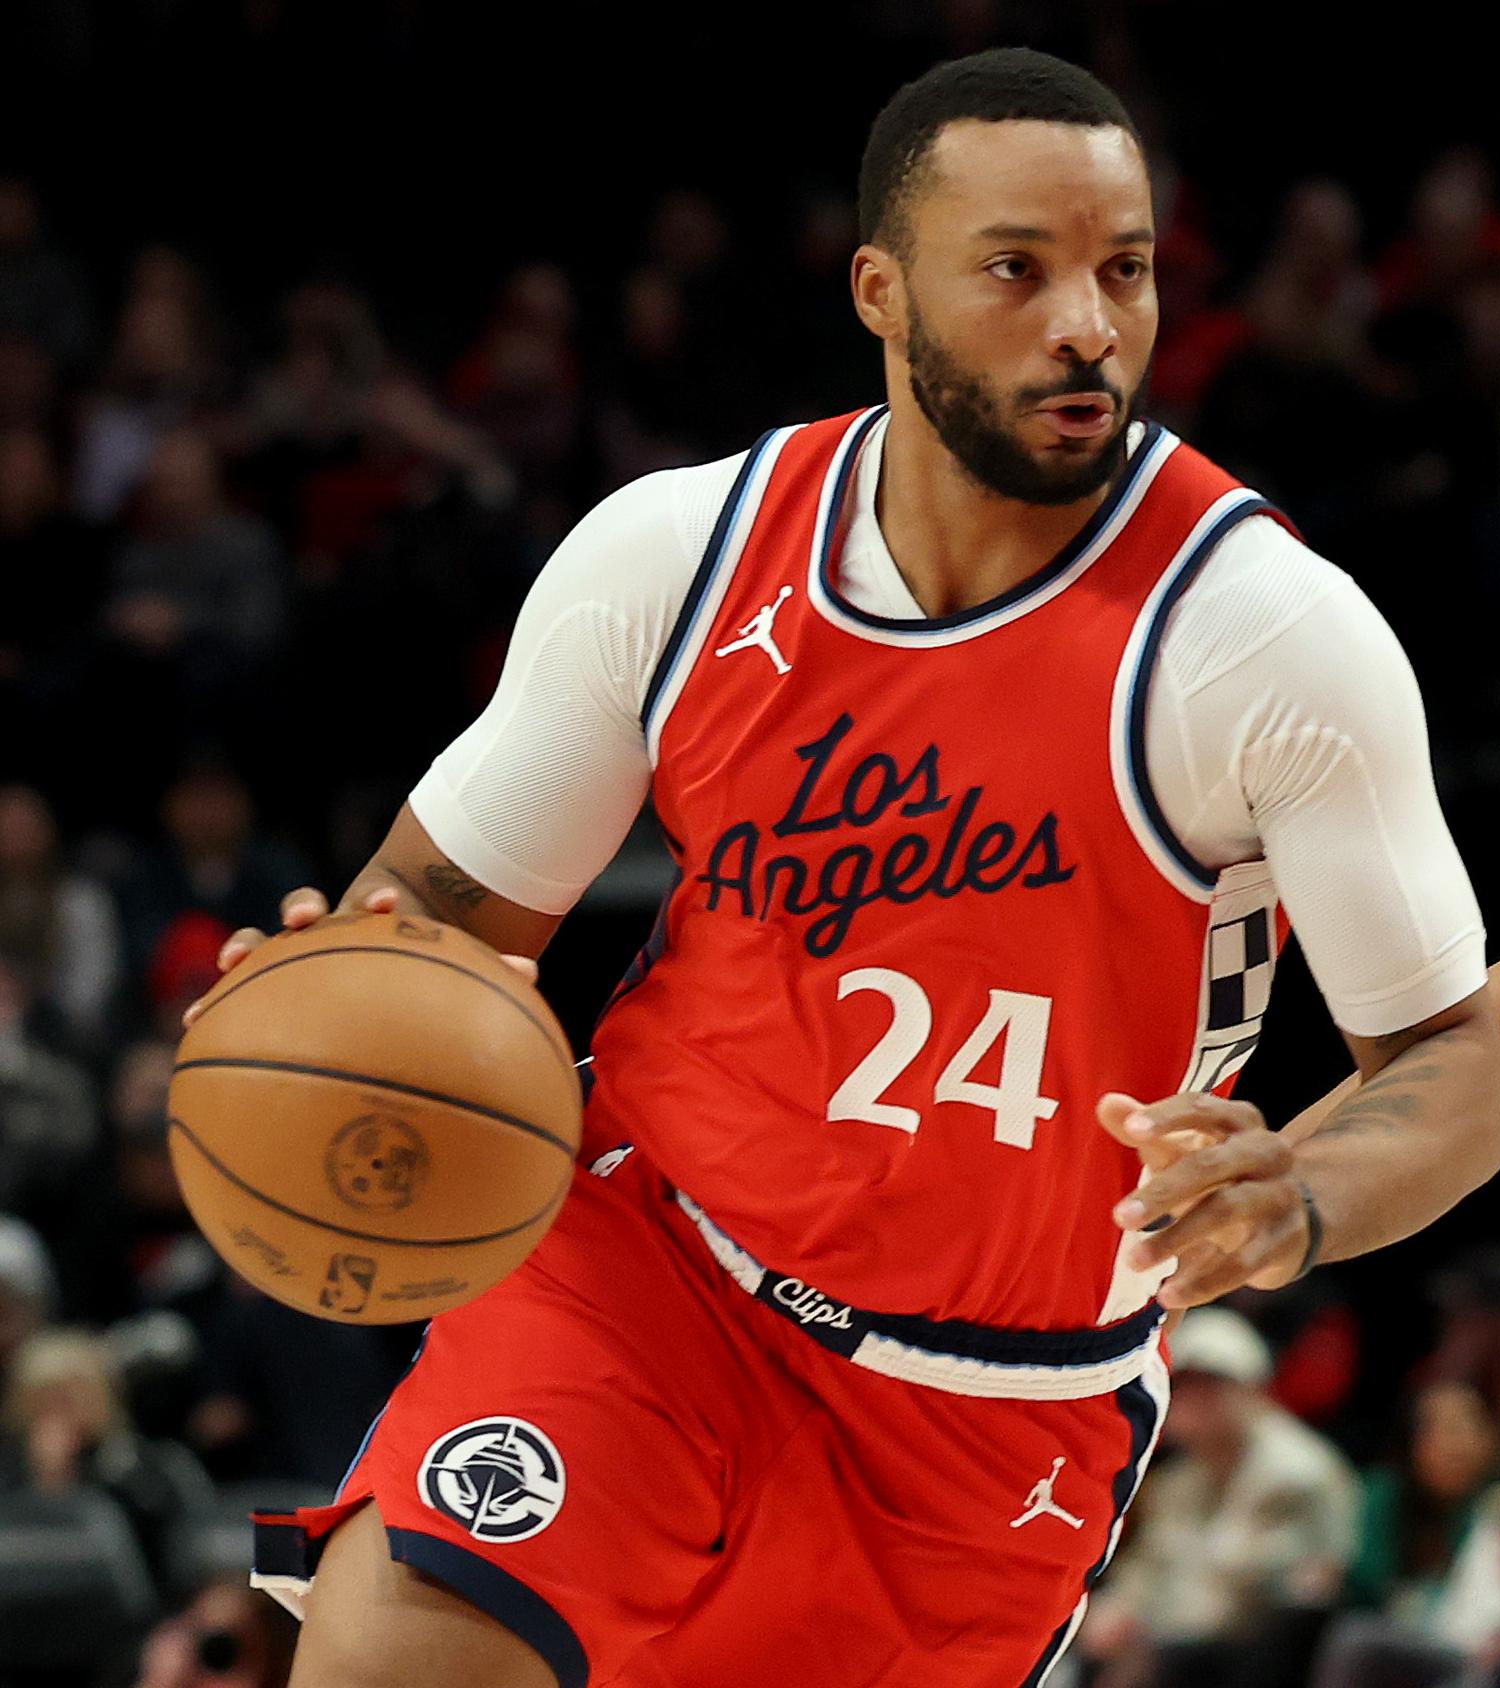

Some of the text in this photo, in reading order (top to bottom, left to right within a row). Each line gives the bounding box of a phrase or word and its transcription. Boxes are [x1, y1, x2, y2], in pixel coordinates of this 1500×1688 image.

[773, 712, 952, 838] Los
[698, 786, 1076, 959] Angeles
[827, 967, 1059, 1150] 24
[772, 1277, 853, 1330] Clips
